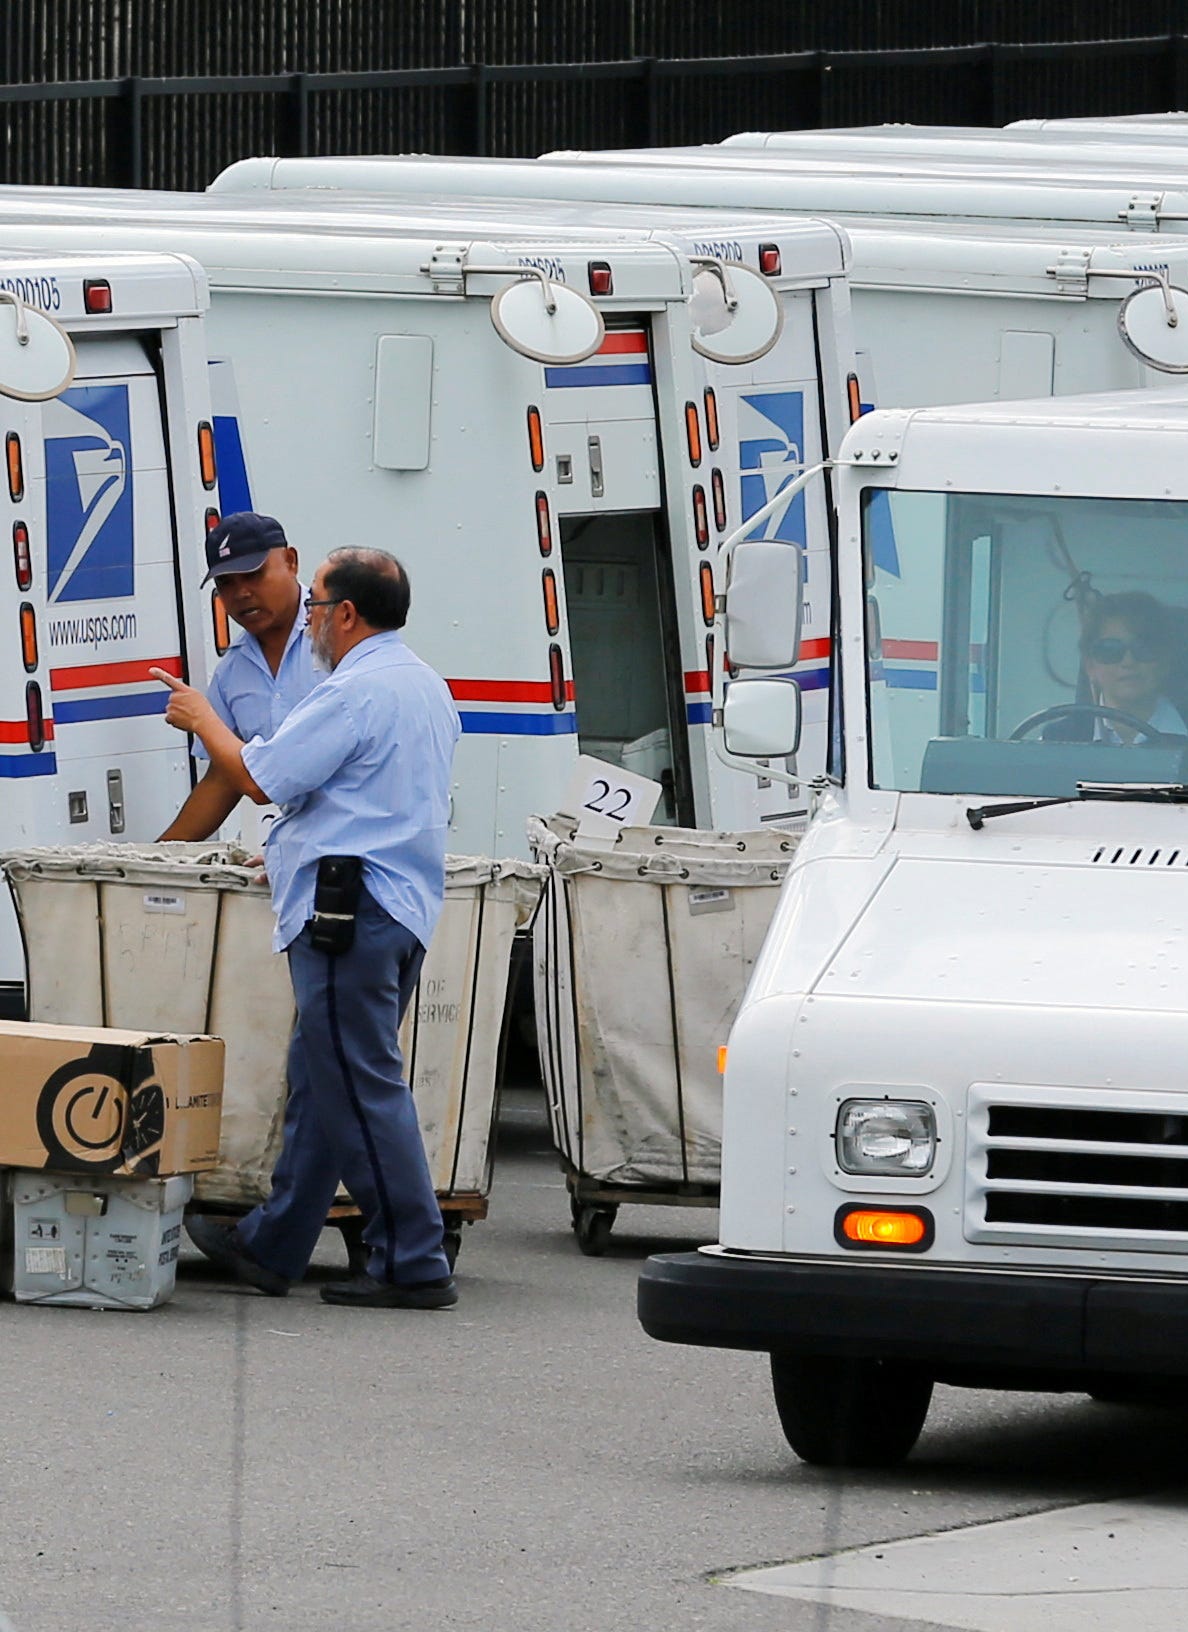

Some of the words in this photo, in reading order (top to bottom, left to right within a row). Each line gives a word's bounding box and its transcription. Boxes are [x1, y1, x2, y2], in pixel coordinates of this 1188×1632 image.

[49, 614, 137, 651] www.usps.com
[584, 779, 631, 821] 22
[427, 980, 446, 998] OF
